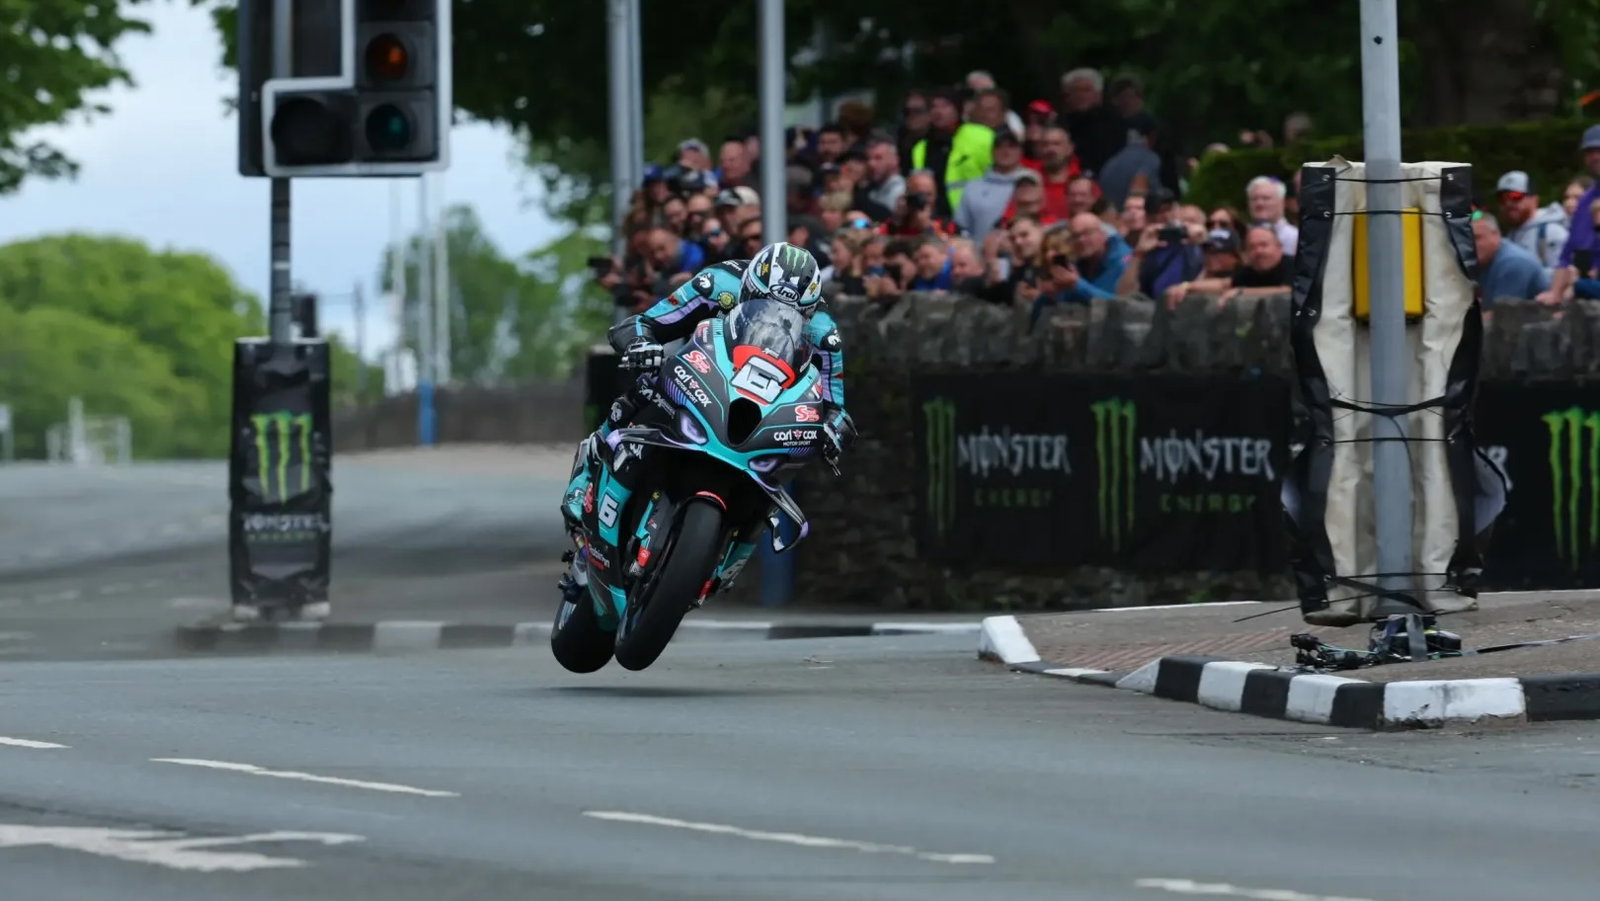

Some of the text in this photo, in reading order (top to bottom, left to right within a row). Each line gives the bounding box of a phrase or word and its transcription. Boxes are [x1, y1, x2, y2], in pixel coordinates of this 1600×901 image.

[771, 286, 797, 300] Arai
[674, 365, 693, 383] carl
[694, 389, 712, 408] cox
[731, 355, 788, 403] 6
[773, 429, 818, 441] carl cox
[957, 425, 1071, 478] MONSTER
[1140, 428, 1274, 485] MONSTER
[599, 494, 619, 528] 6
